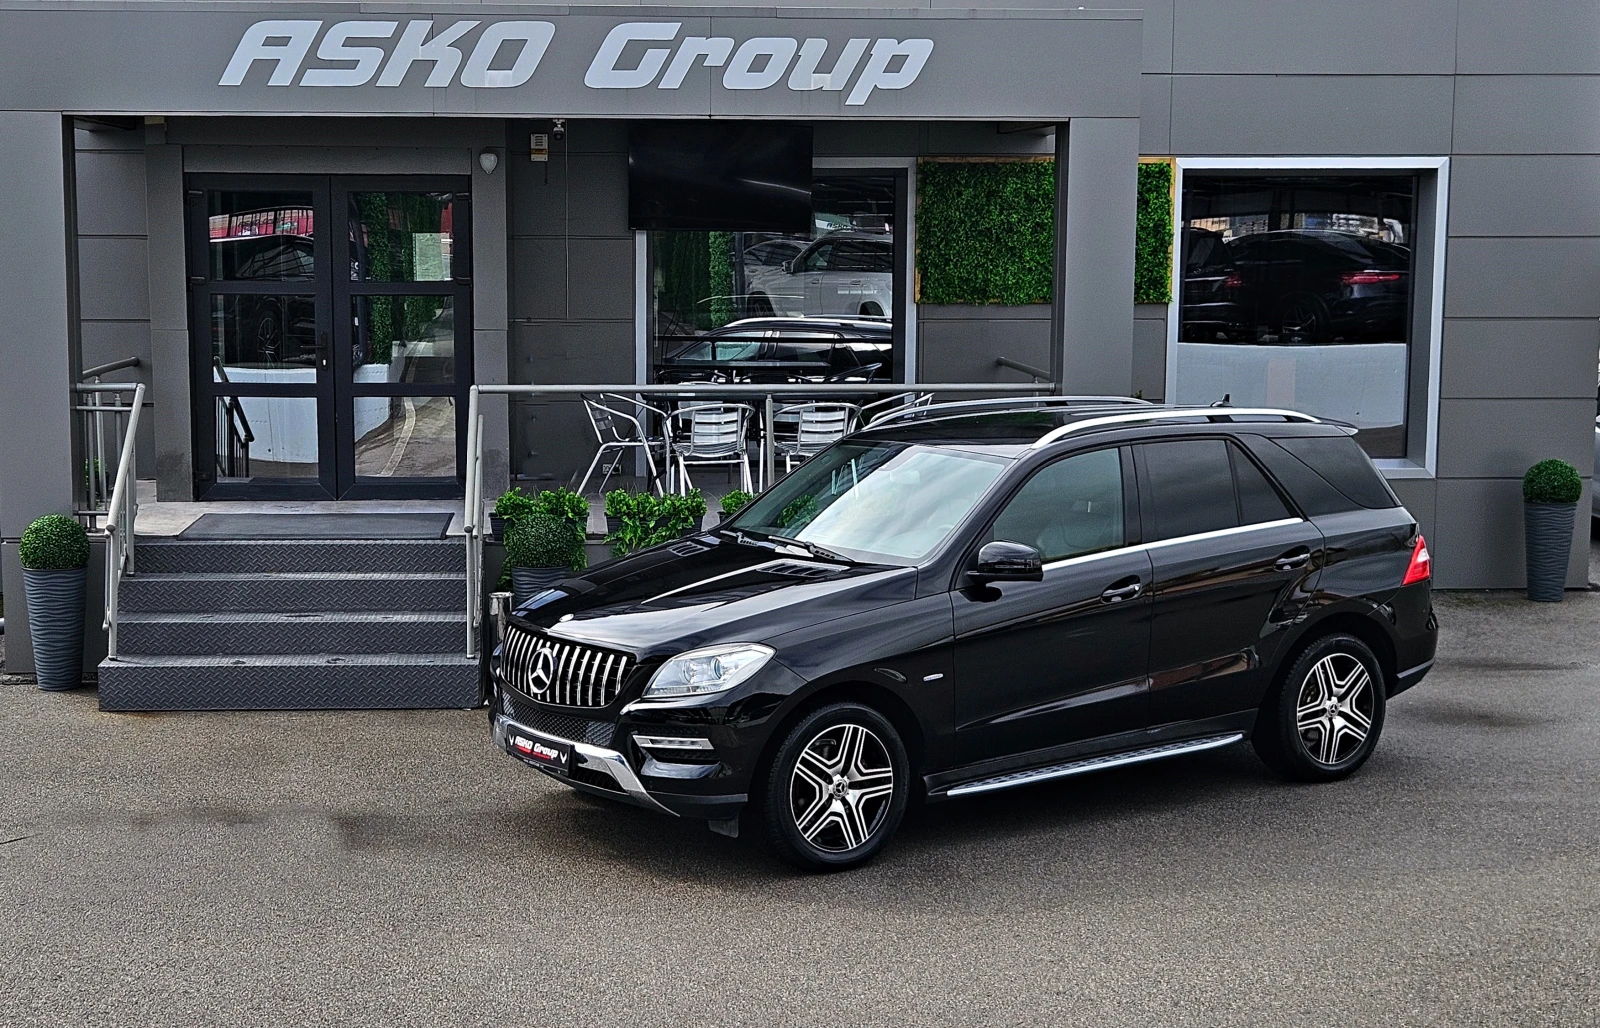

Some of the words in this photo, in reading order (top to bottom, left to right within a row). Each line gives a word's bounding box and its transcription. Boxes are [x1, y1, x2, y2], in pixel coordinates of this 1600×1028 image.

[218, 20, 555, 87] ASKO
[584, 22, 934, 106] Group
[515, 736, 533, 750] ASKO
[534, 743, 558, 760] Group
